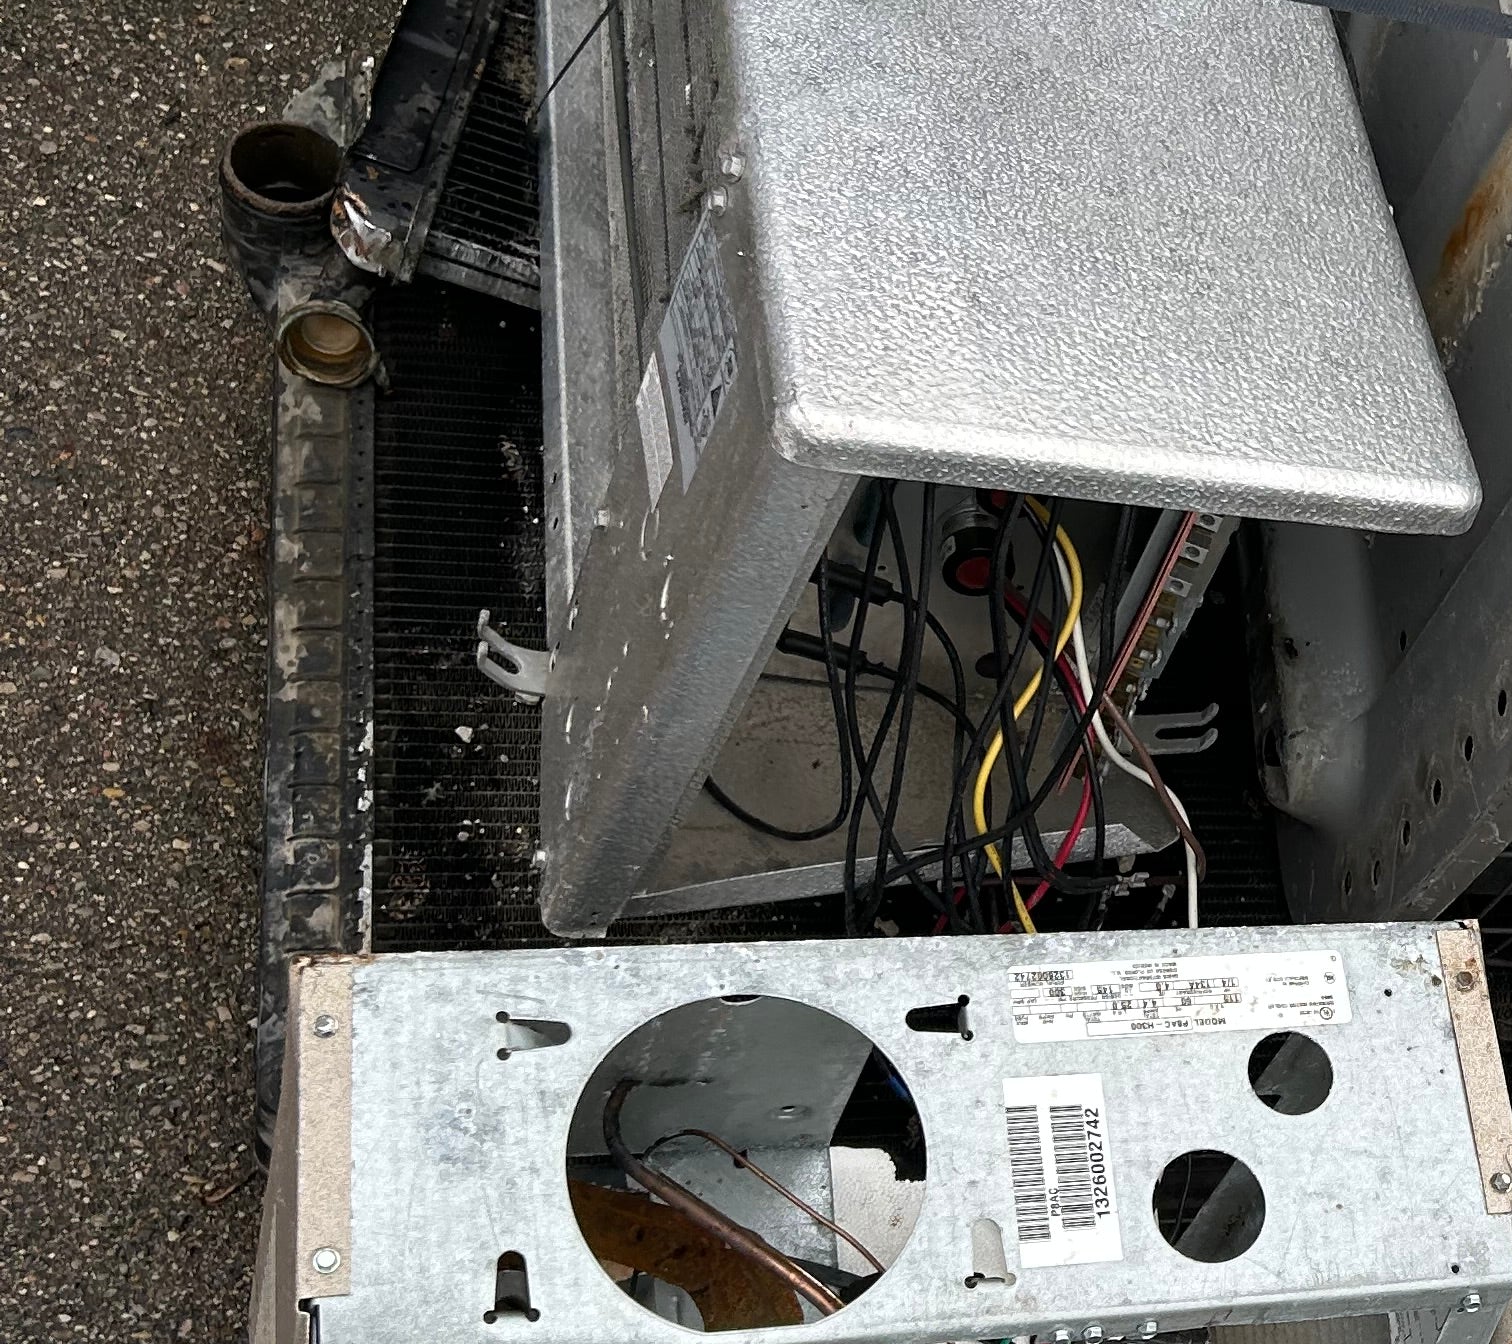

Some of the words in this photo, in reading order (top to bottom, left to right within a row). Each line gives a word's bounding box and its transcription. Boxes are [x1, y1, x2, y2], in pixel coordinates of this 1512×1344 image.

[1194, 1017, 1225, 1025] MODEL
[1085, 1107, 1111, 1219] 1326002742
[1049, 1188, 1061, 1217] P8AC
